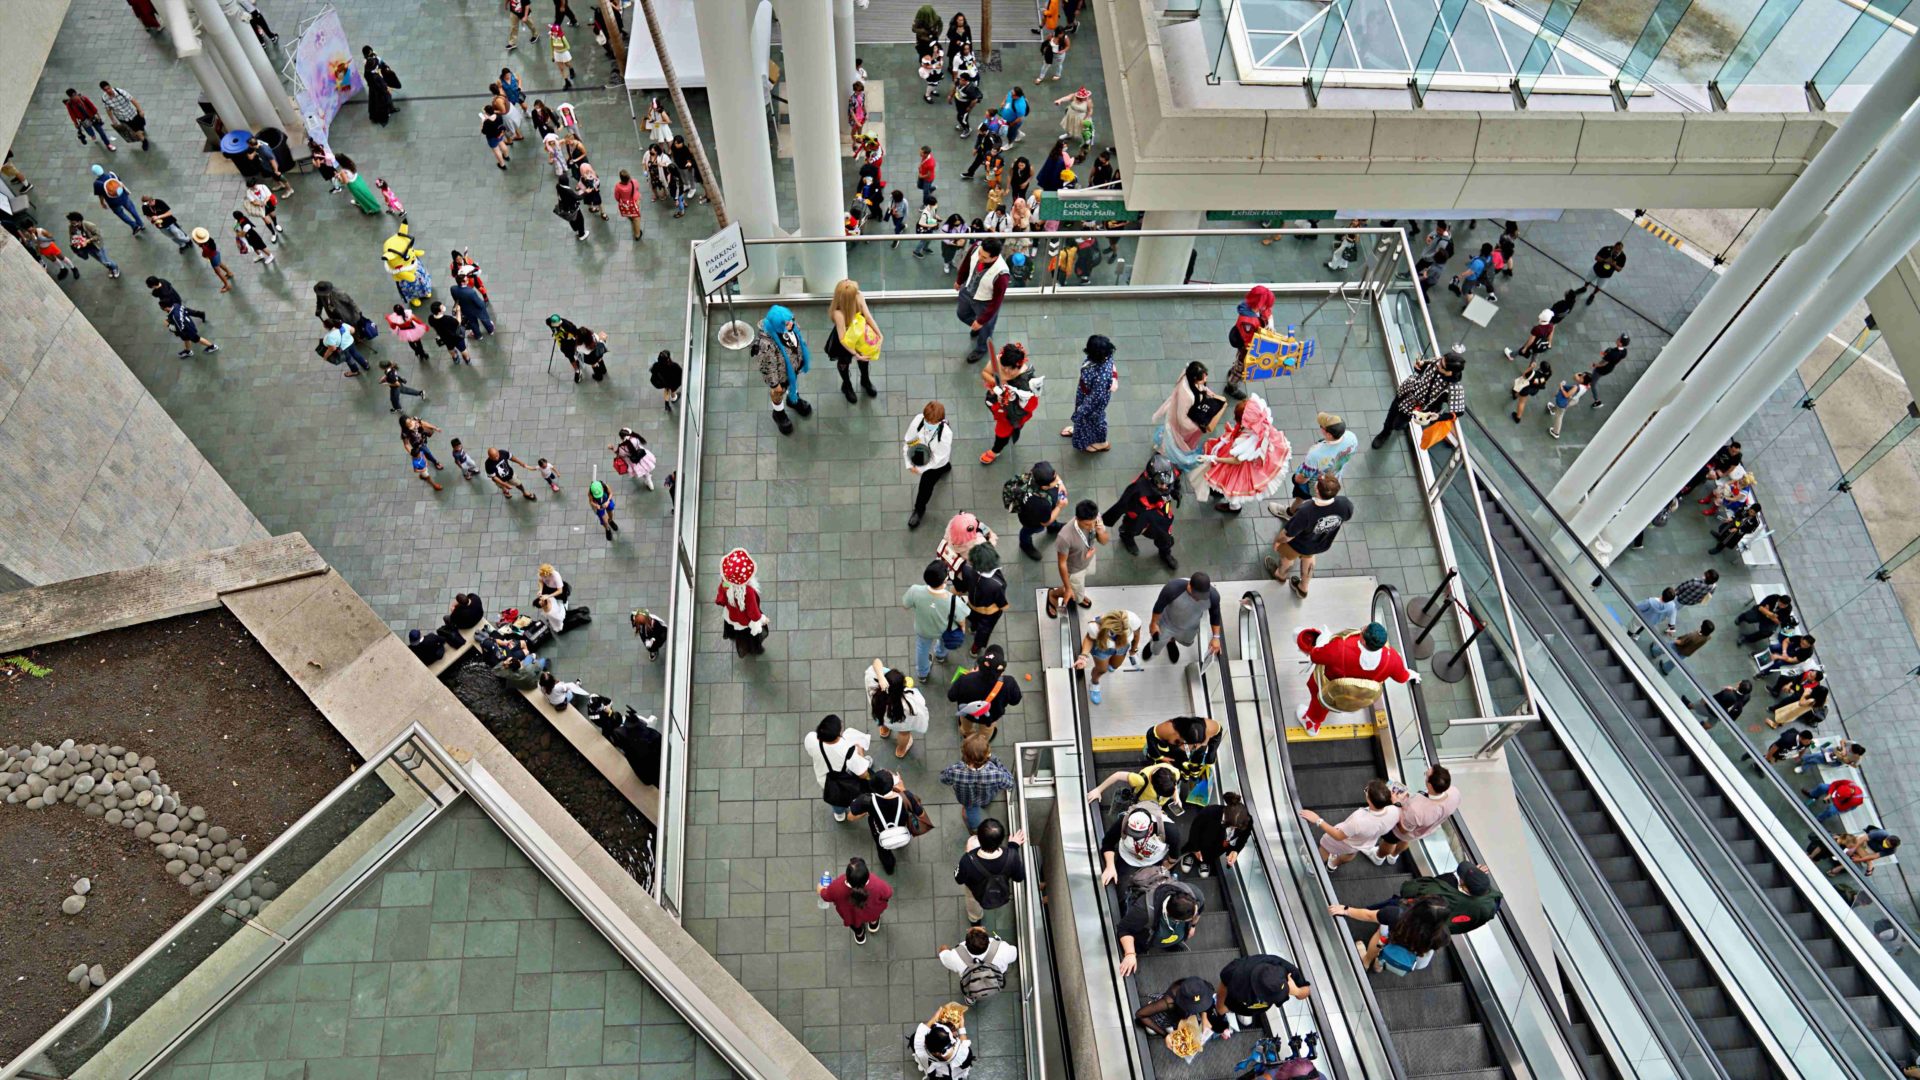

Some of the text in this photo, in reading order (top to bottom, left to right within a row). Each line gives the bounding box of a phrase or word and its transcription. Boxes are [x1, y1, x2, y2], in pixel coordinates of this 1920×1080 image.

[1064, 201, 1090, 209] Lobby
[705, 241, 737, 267] PARKING
[708, 251, 737, 274] GARAGE
